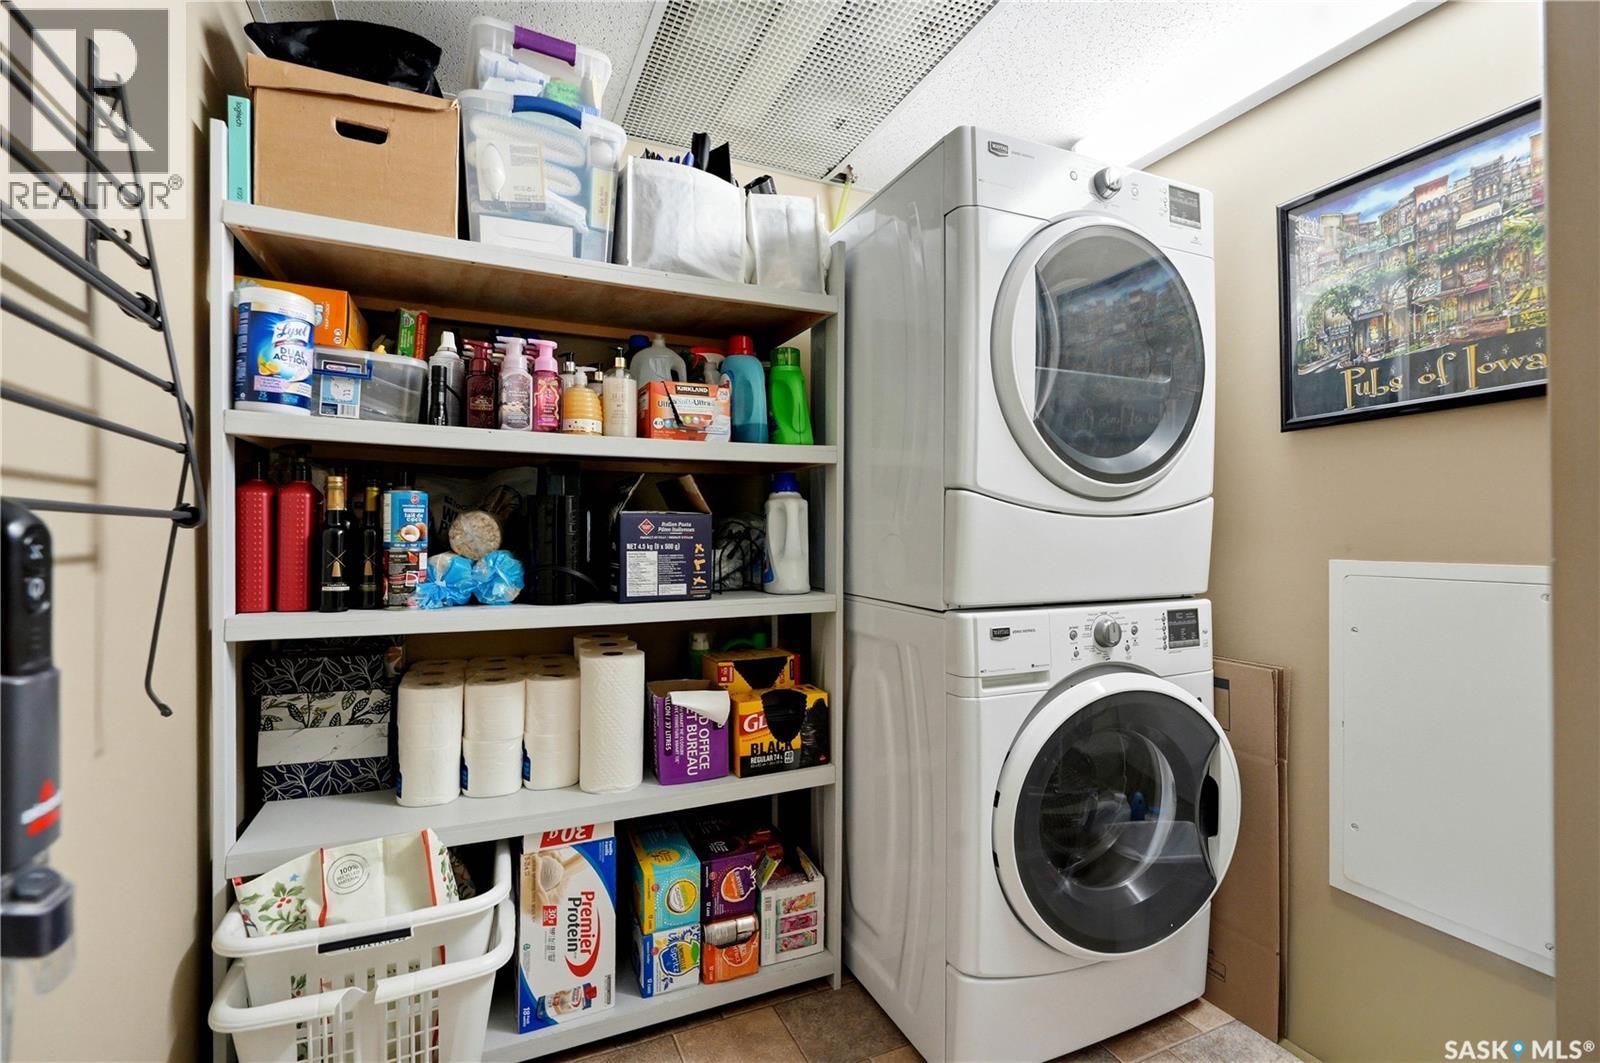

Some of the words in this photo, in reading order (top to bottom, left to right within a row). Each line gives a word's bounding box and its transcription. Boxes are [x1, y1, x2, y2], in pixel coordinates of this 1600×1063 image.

[233, 101, 244, 128] logitech
[276, 322, 308, 340] Lysol
[273, 353, 308, 367] ACTION
[280, 346, 305, 359] DUAL
[1341, 366, 1404, 410] Pubs
[1417, 352, 1457, 387] of
[1463, 344, 1548, 392] Iowa
[646, 543, 653, 551] kg
[665, 721, 671, 729] 37
[743, 712, 768, 733] GL
[664, 730, 672, 751] LITRES
[686, 724, 698, 776] BUREAU
[698, 728, 710, 770] OFFICE
[750, 755, 773, 764] REGULAR
[339, 865, 359, 874] 100%
[567, 897, 581, 953] Protein
[580, 891, 595, 956] Premier
[670, 946, 679, 973] Spritz
[522, 1006, 530, 1016] 18
